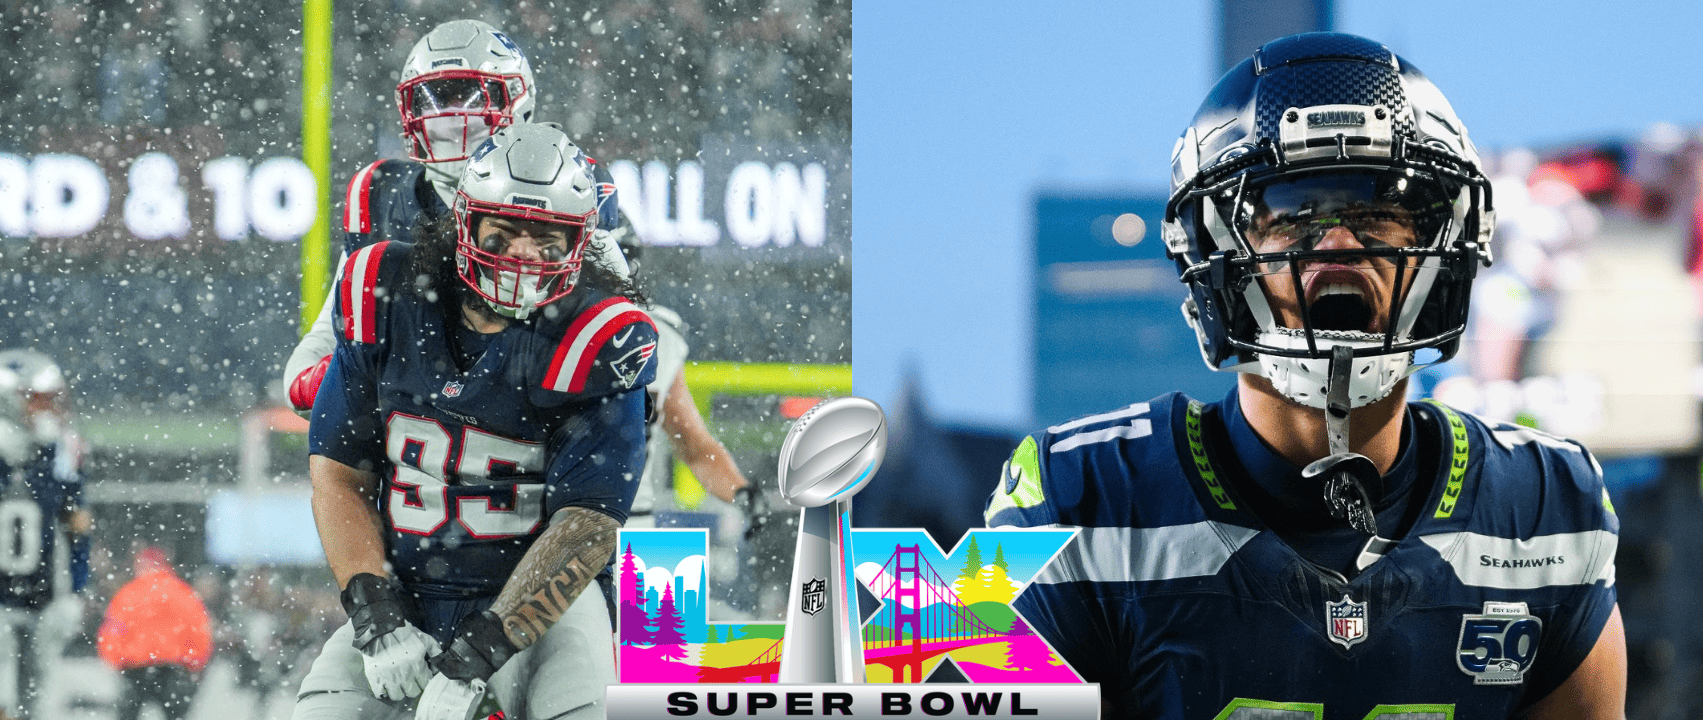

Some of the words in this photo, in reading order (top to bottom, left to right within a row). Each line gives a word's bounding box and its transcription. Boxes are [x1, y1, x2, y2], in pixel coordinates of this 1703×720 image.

[1307, 110, 1365, 127] SEAHAWKS
[123, 151, 191, 240] &
[202, 155, 318, 242] 10
[724, 160, 827, 248] ON
[386, 411, 546, 539] 95
[1334, 618, 1361, 638] NFL
[1459, 619, 1541, 673] 50
